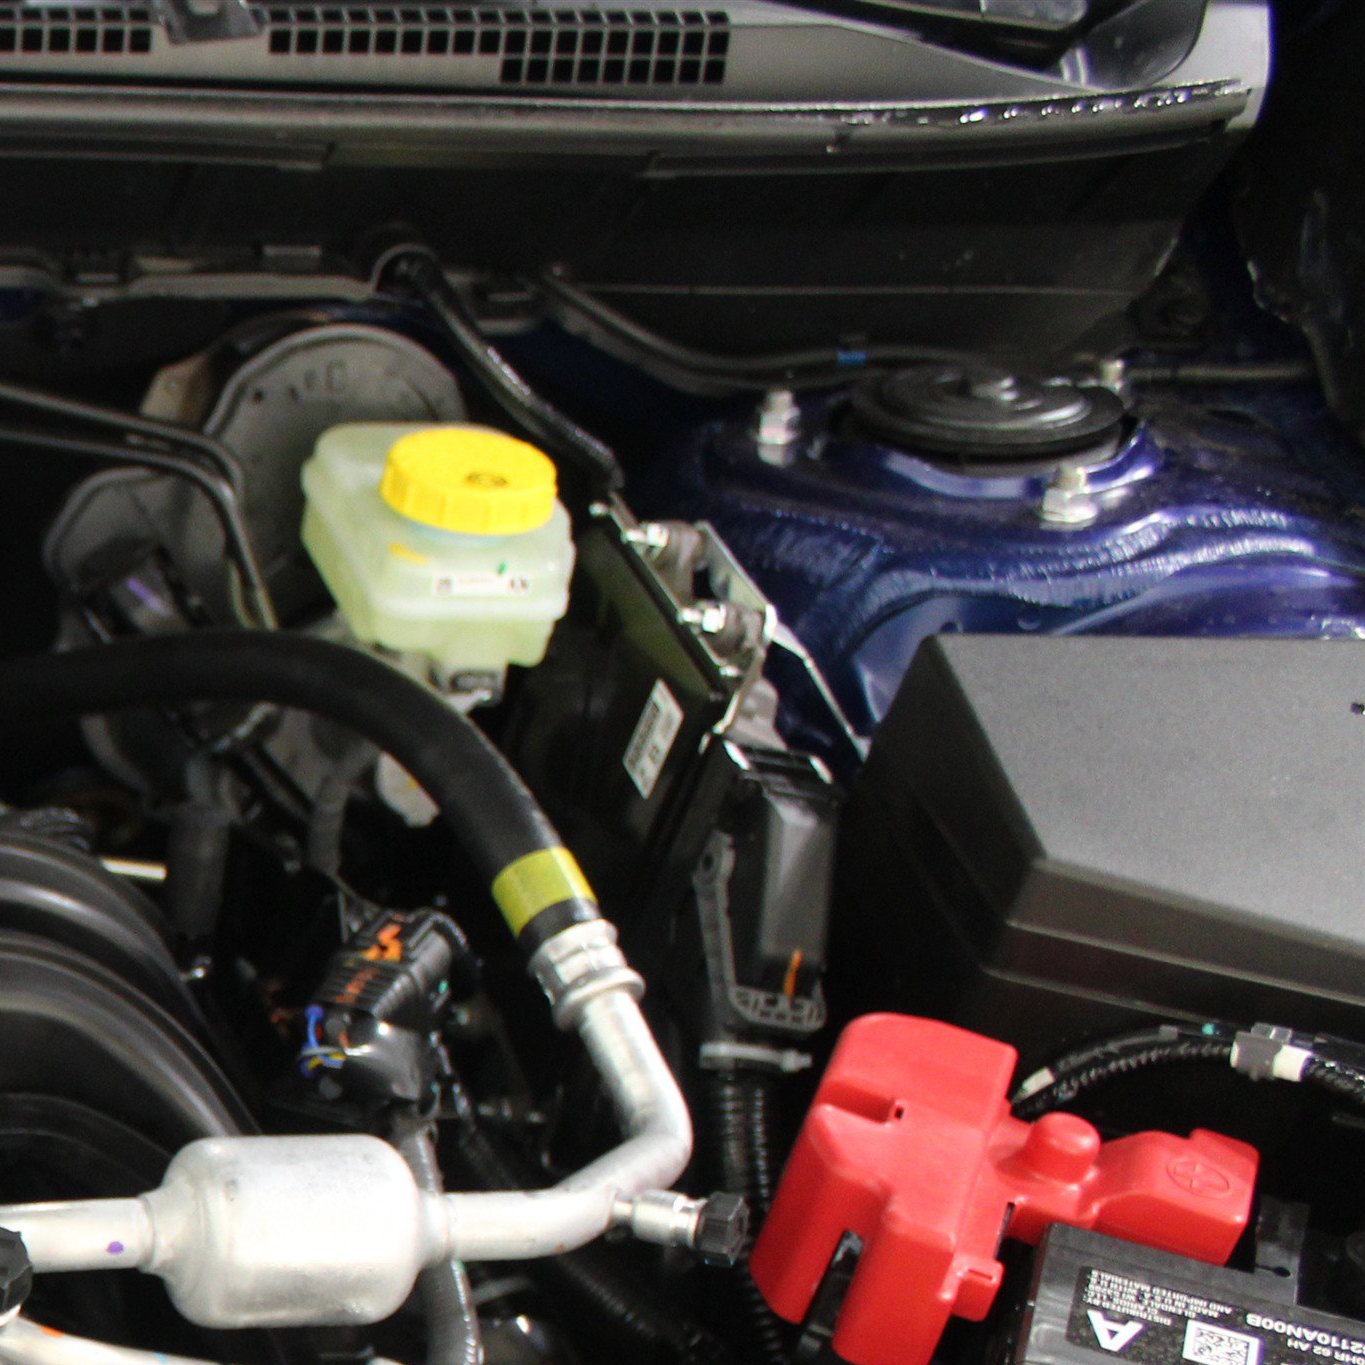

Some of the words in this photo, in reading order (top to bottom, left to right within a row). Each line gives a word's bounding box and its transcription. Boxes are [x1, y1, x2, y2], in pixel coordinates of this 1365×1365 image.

[1091, 1269, 1151, 1293] MATERIALS
[1102, 1300, 1172, 1326] DISTRIBUTED
[1245, 1313, 1365, 1355] 2110AN00B
[1286, 1338, 1312, 1352] AH
[1313, 1345, 1333, 1358] 62
